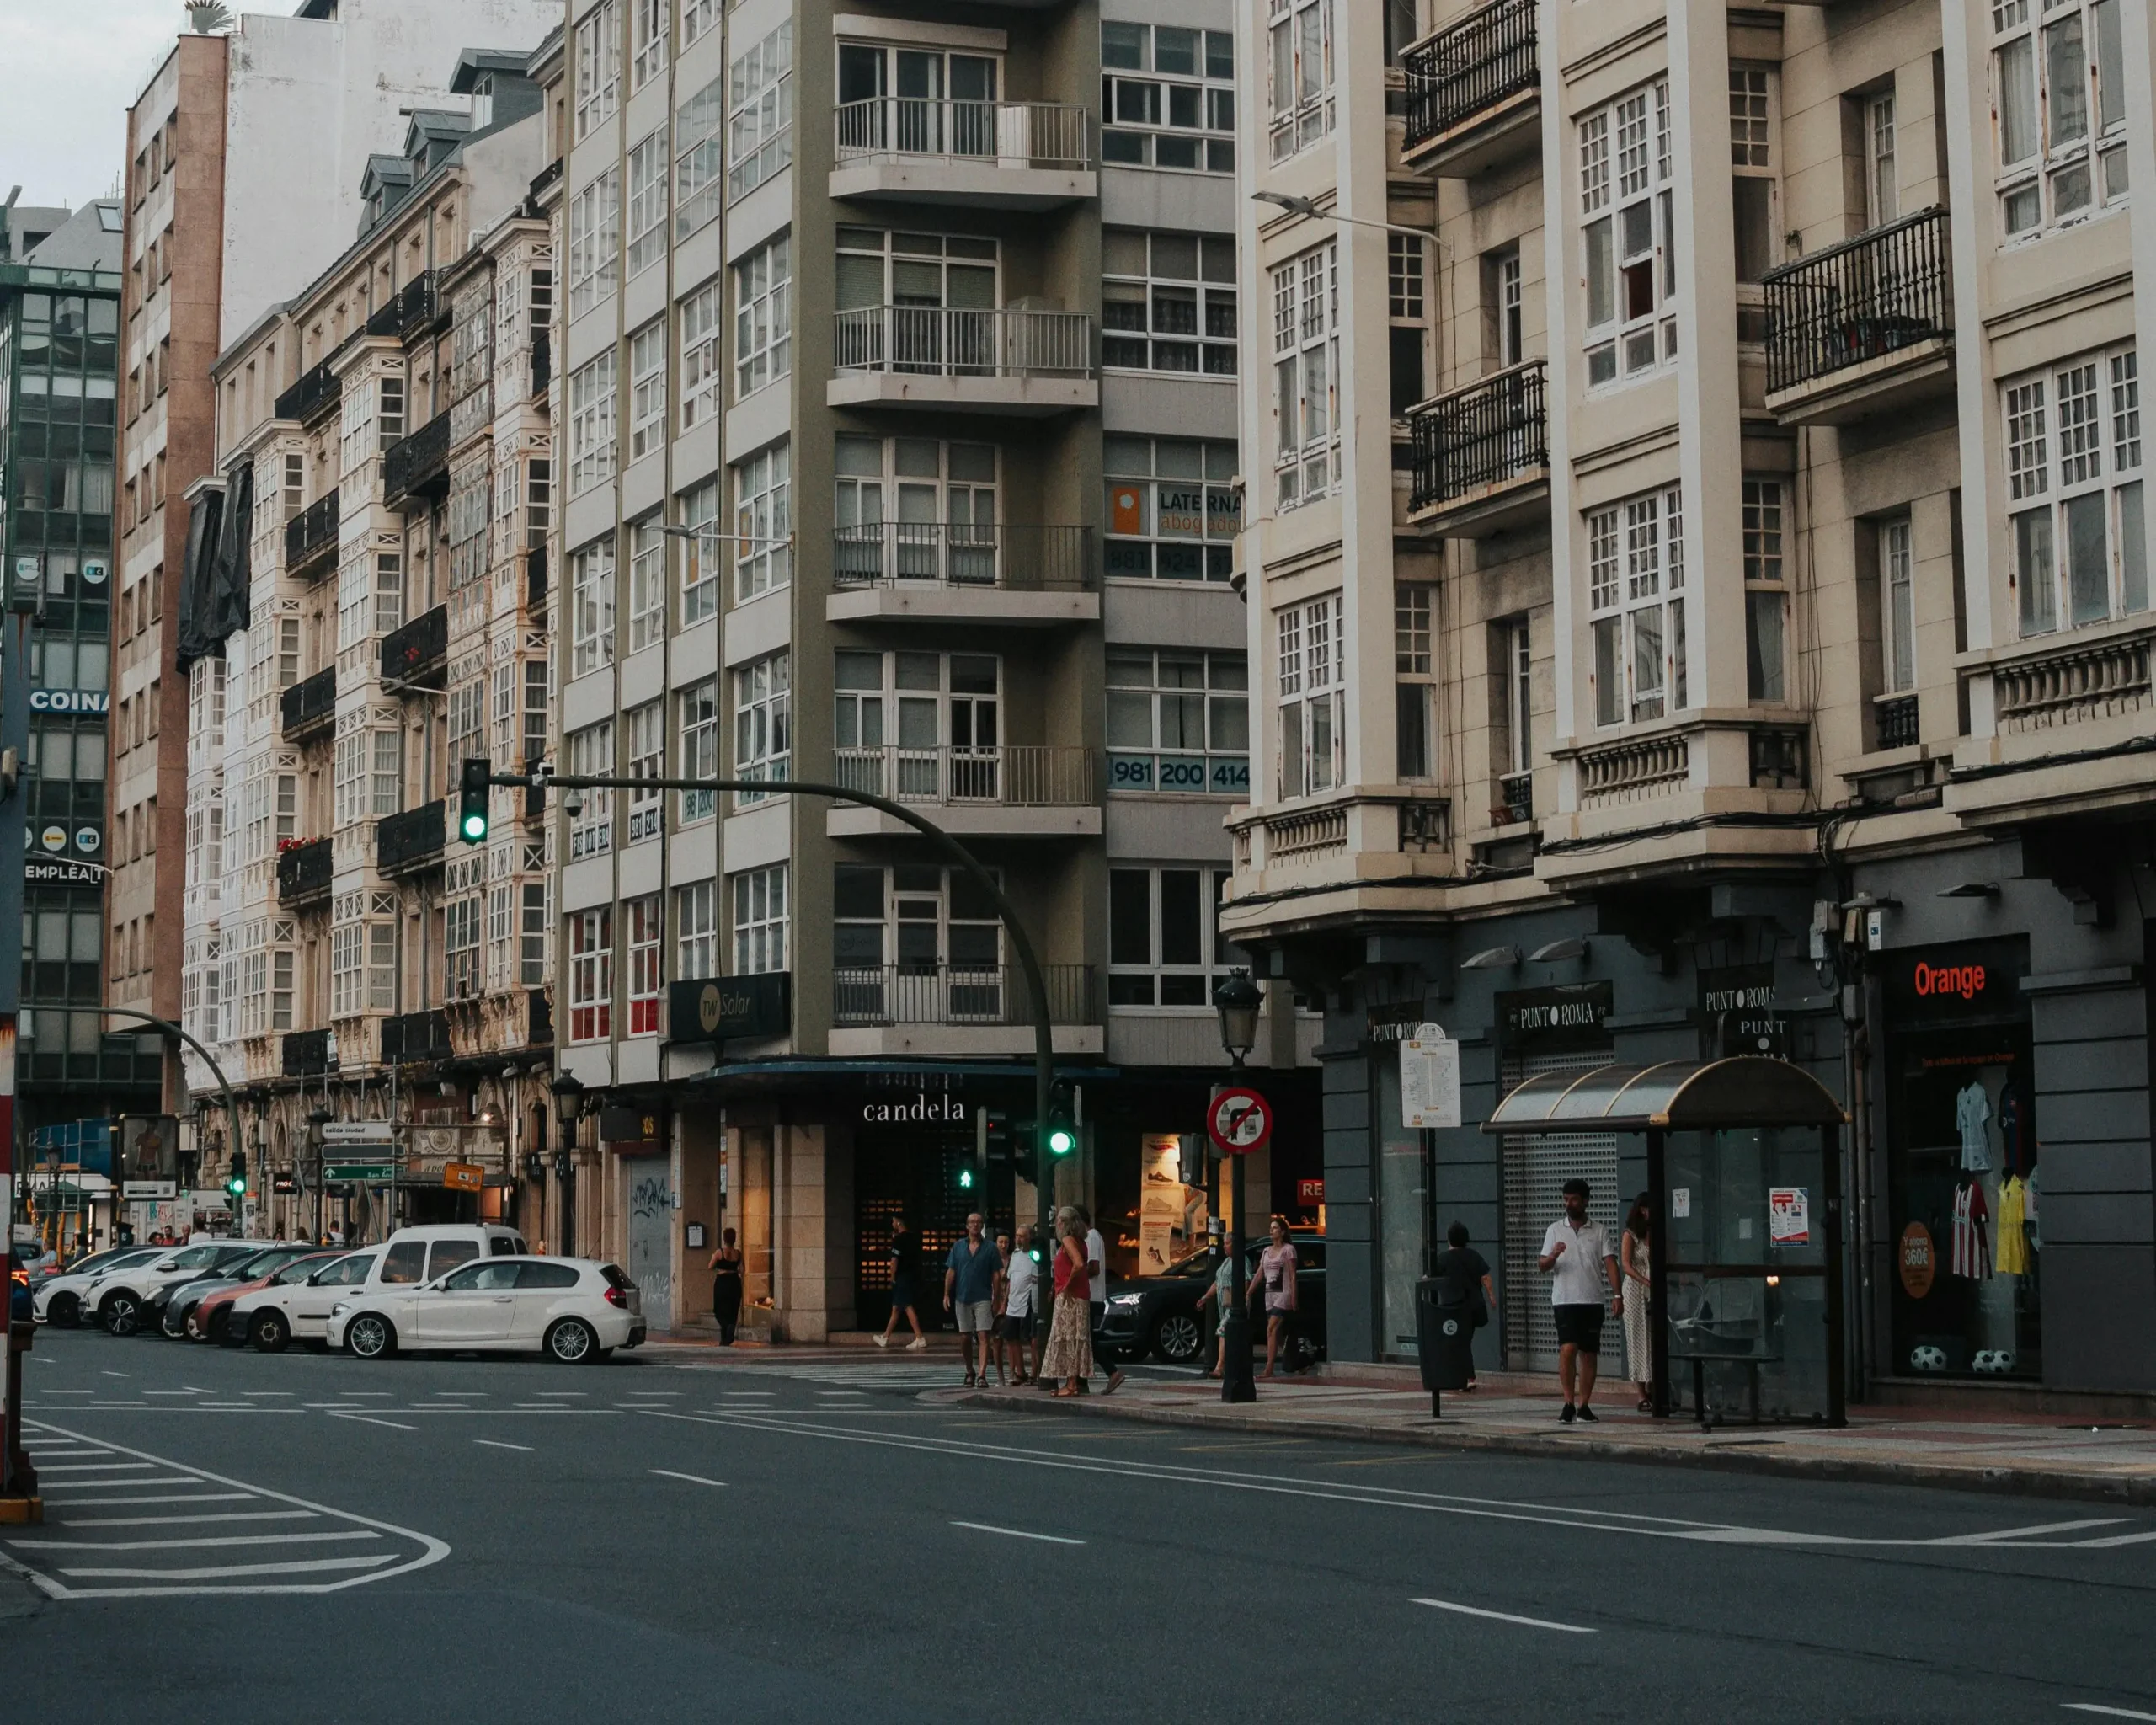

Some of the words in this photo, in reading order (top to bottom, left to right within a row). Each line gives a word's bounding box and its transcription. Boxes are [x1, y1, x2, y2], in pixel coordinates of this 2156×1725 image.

[1114, 761, 1152, 782] 981
[1161, 763, 1204, 784] 200
[1213, 765, 1250, 786] 414
[1915, 962, 1985, 999] Orange
[721, 991, 750, 1016] Solar
[1561, 1002, 1593, 1025] ROMA
[1741, 1020, 1786, 1034] PUNT
[863, 1093, 965, 1121] candela
[1303, 1183, 1323, 1196] RE
[1905, 1247, 1929, 1265] 360€
